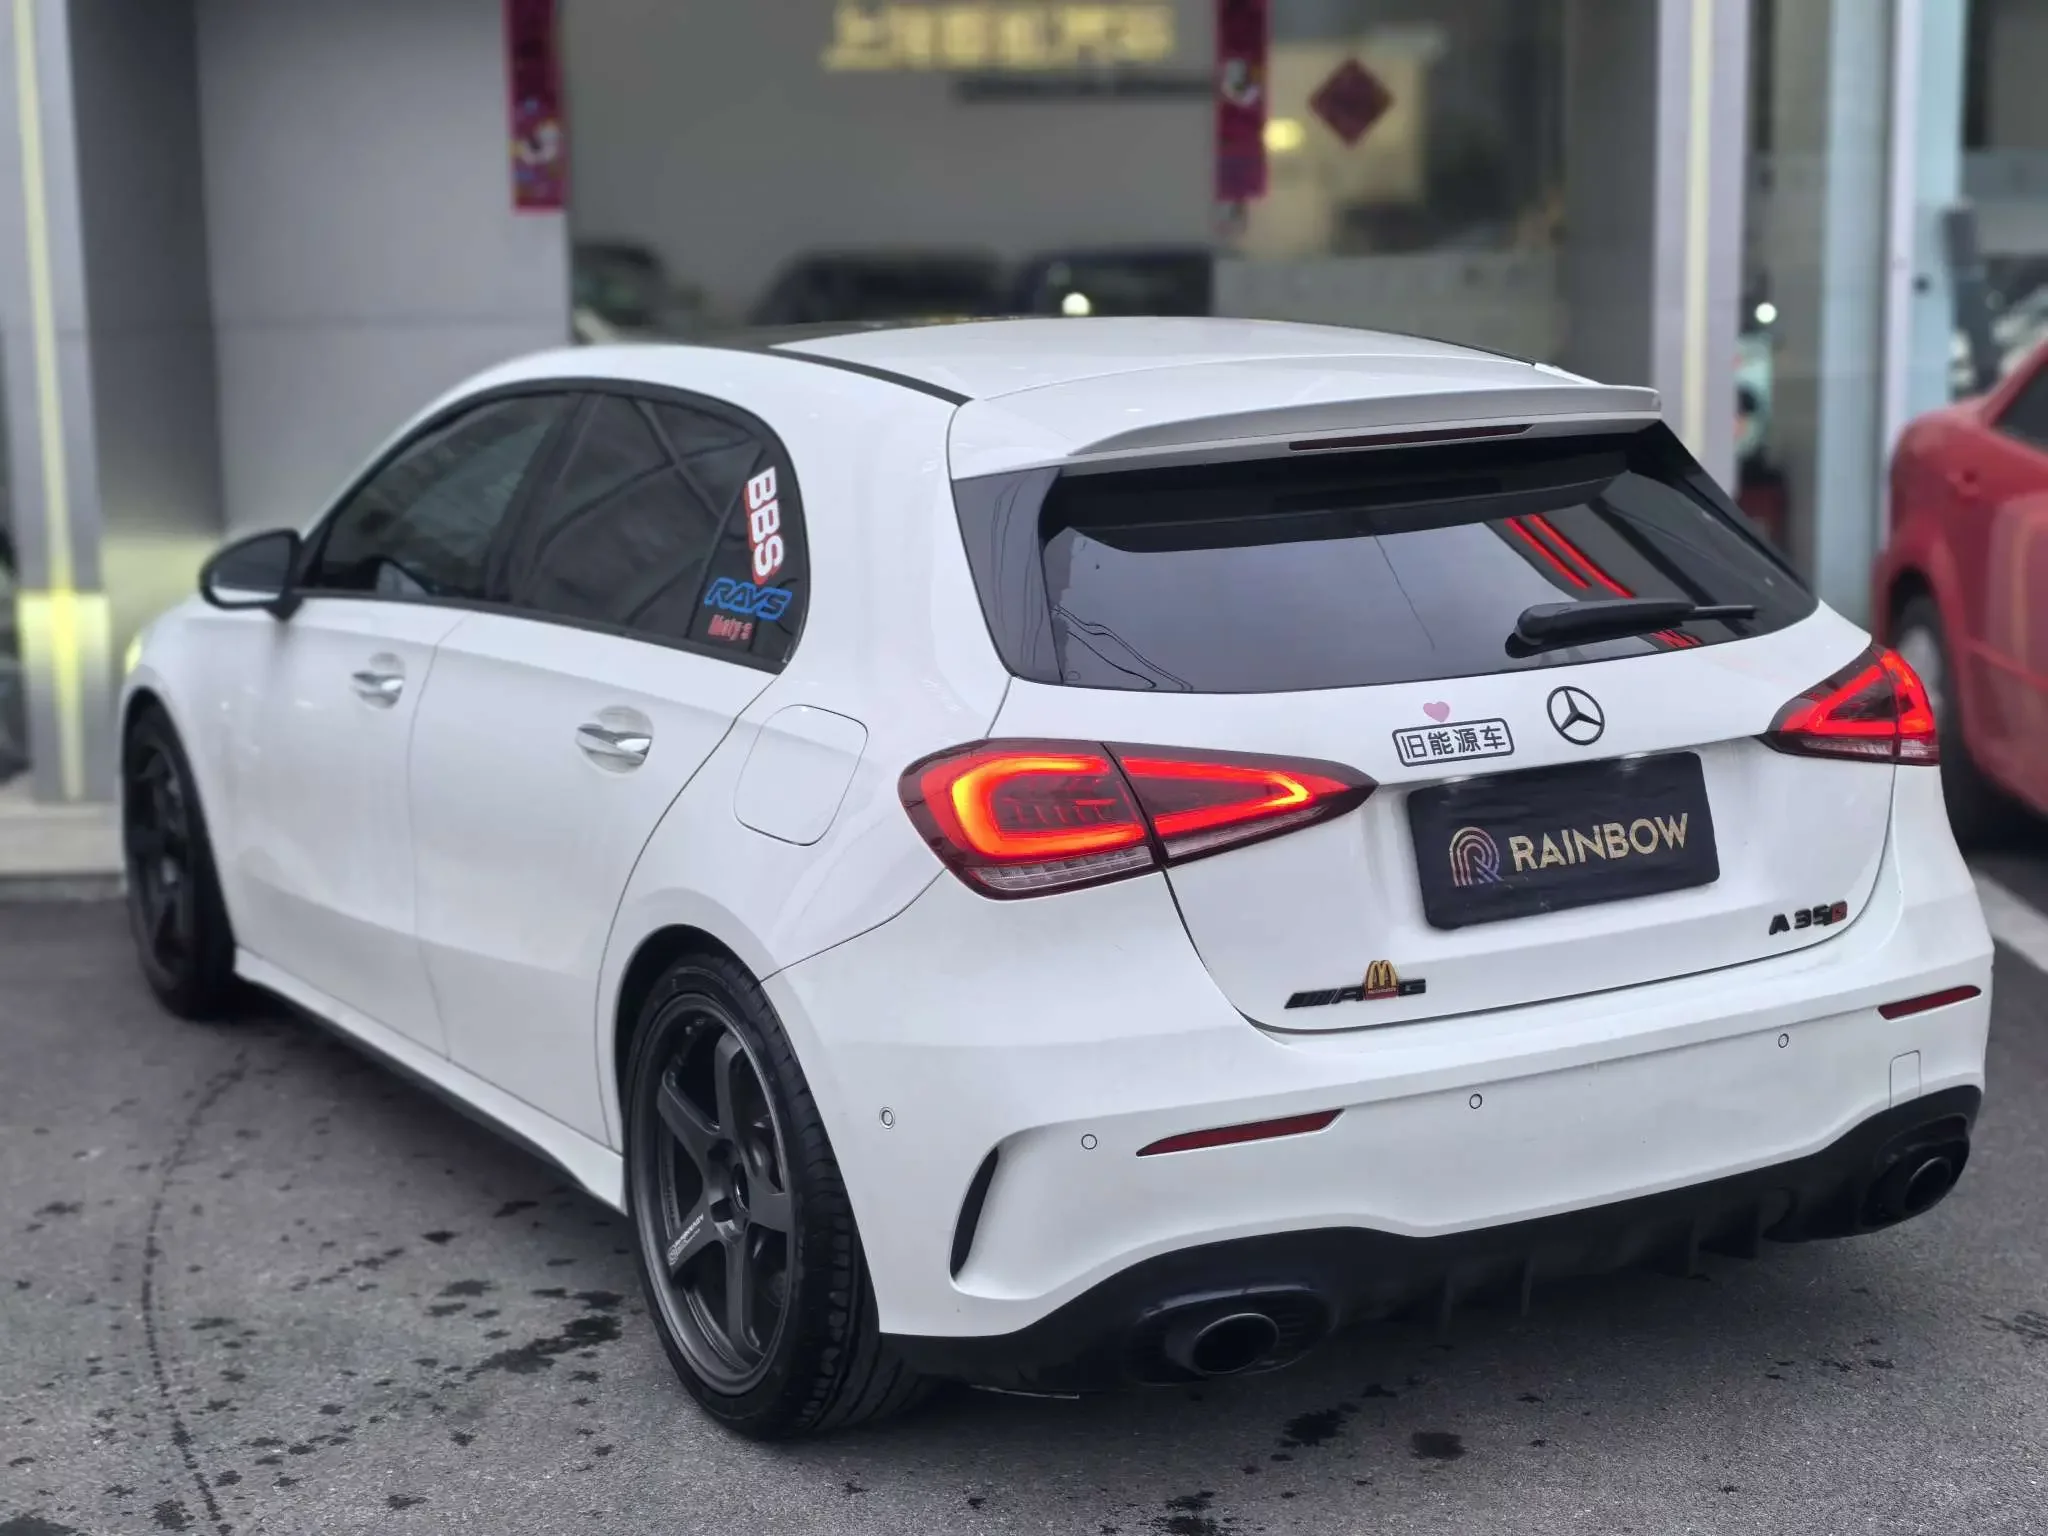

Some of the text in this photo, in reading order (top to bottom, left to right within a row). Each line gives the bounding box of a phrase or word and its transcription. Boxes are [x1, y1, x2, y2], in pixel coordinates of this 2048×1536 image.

[747, 467, 784, 579] BBS
[704, 577, 792, 620] RAYS
[1401, 726, 1506, 759] 旧能源车
[1509, 813, 1688, 872] RAINBOW
